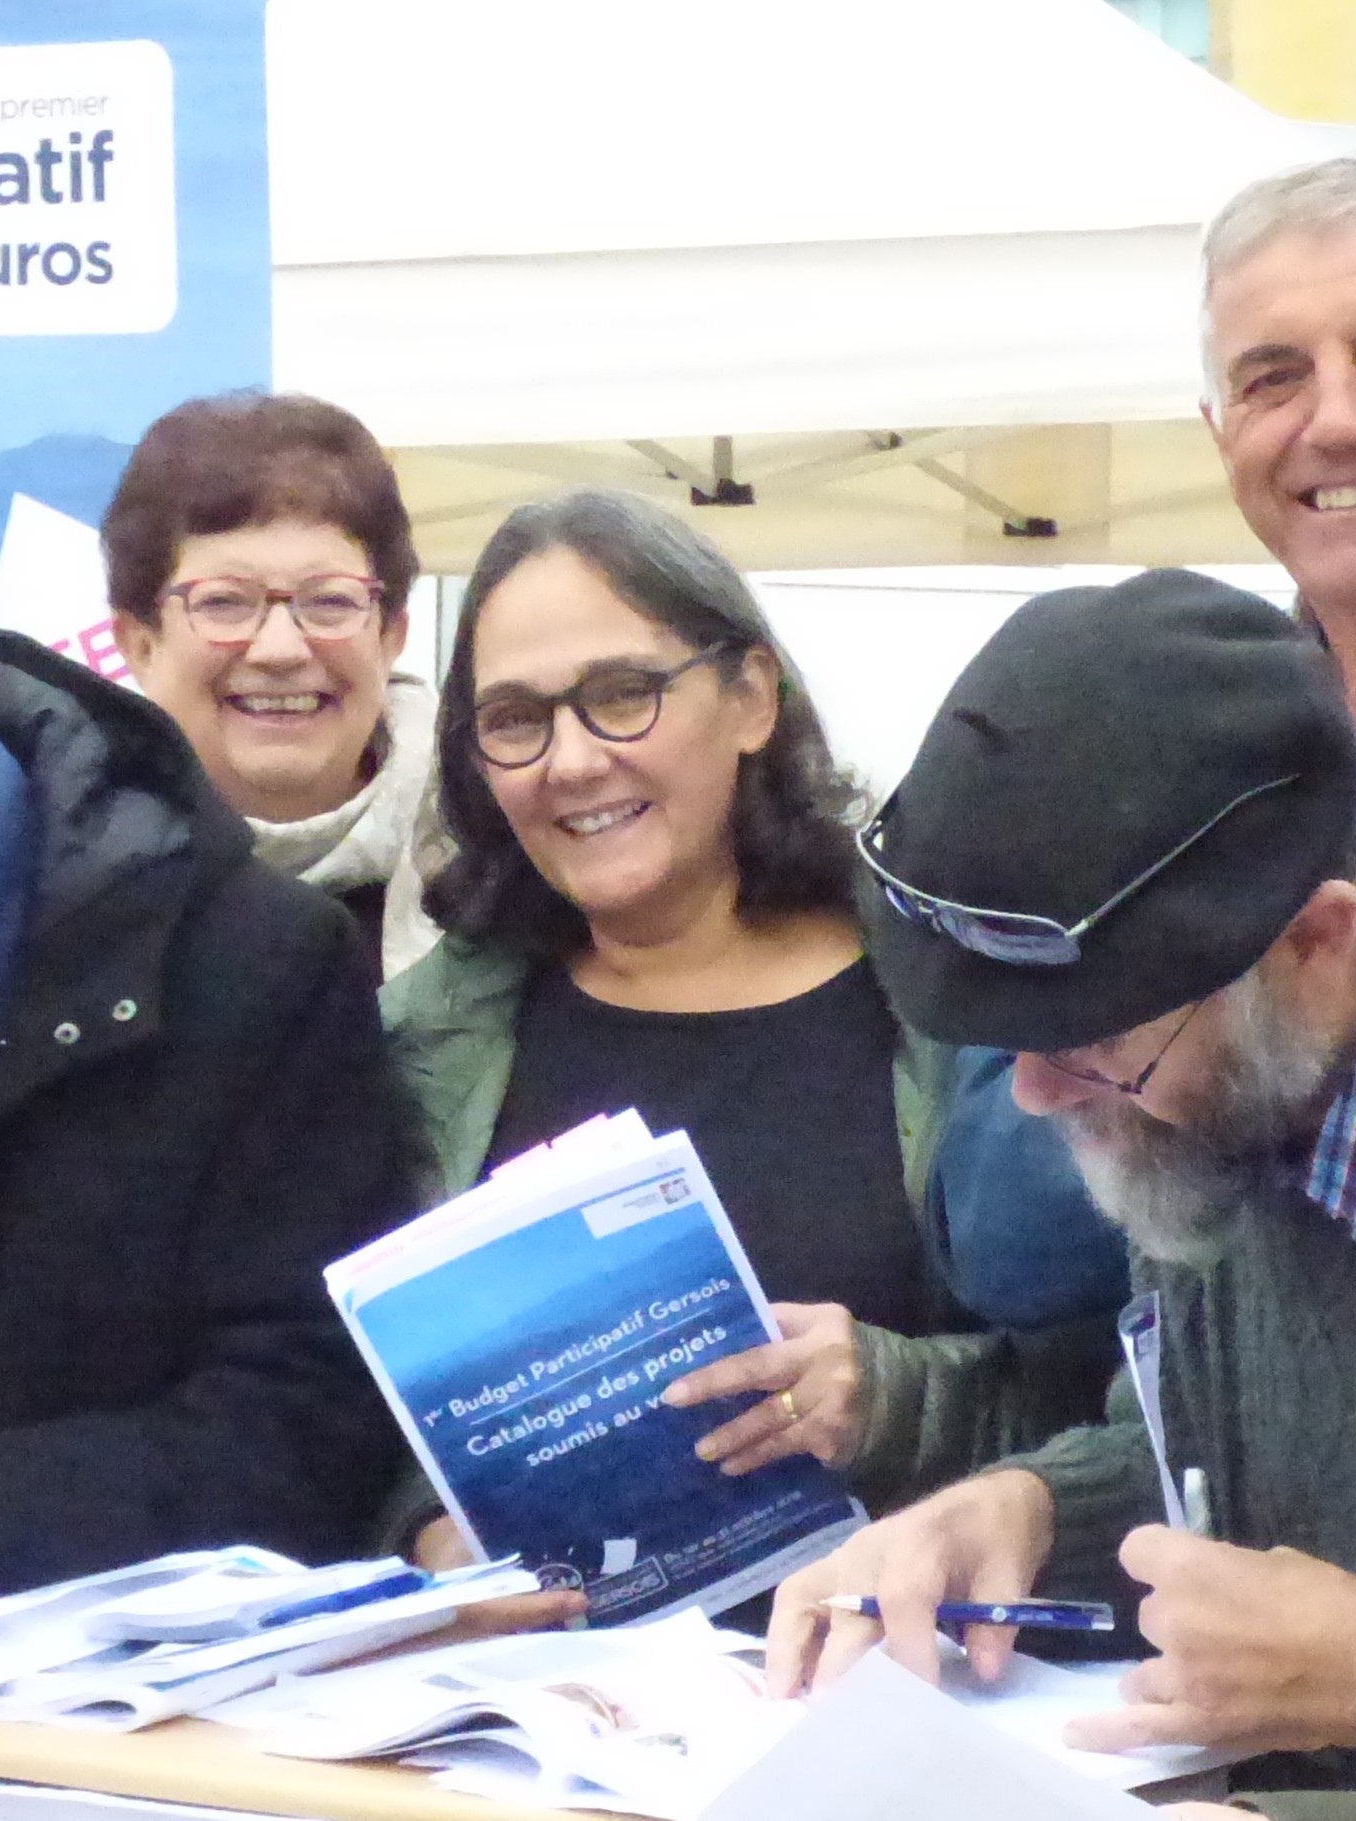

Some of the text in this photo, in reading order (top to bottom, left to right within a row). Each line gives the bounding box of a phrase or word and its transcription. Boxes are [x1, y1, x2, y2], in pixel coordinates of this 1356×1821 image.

[0, 91, 109, 123] premier
[448, 1373, 530, 1418] Budget
[529, 1310, 645, 1381] Participatif
[648, 1278, 731, 1320] Gersois
[466, 1326, 727, 1456] Catalogue des projets
[526, 1421, 610, 1468] soumis
[613, 1405, 642, 1428] au
